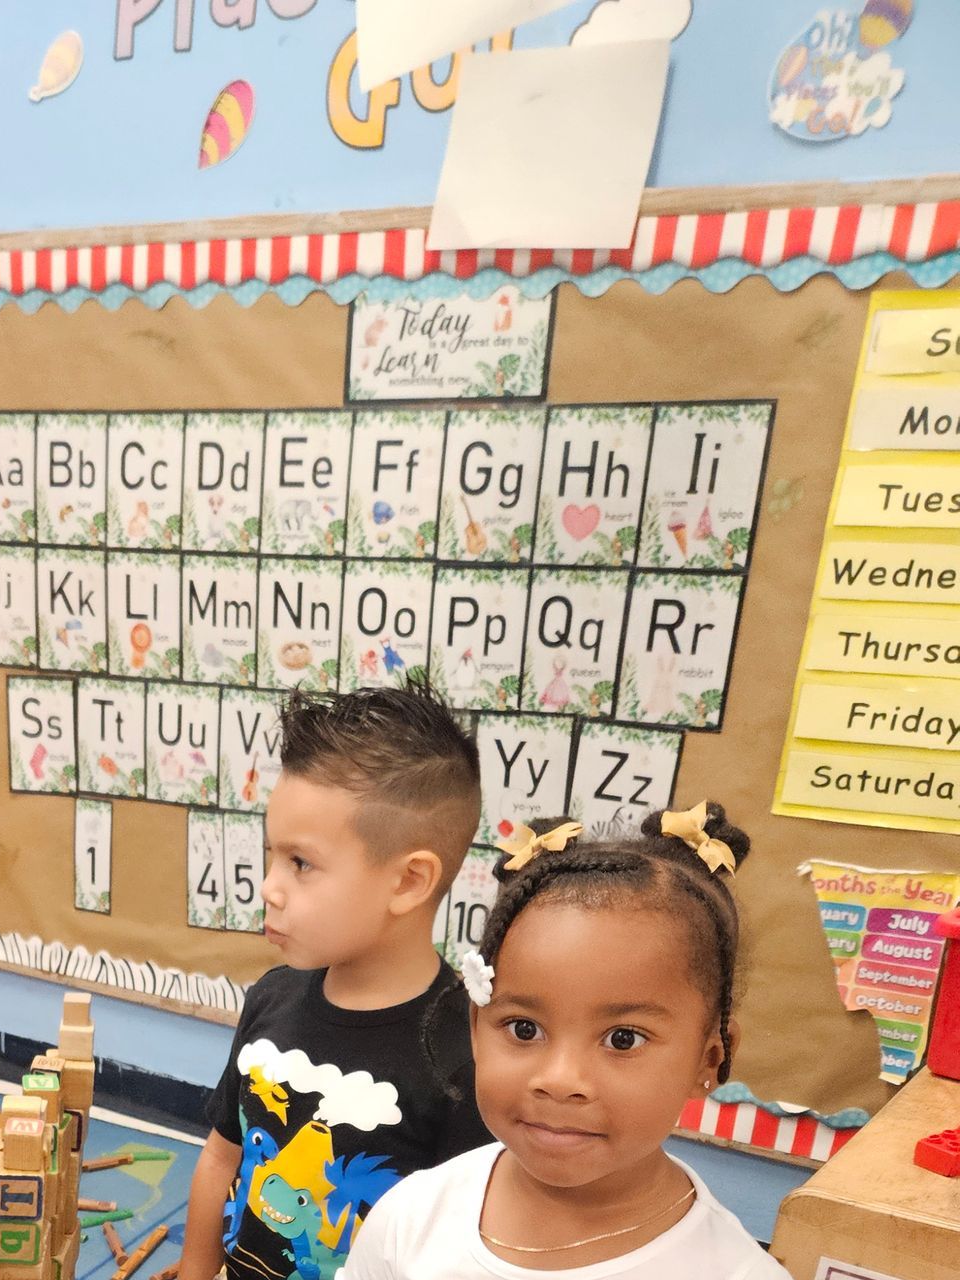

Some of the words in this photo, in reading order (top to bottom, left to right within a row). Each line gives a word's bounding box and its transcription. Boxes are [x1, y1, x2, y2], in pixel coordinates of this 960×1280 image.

[397, 303, 472, 353] Today
[493, 335, 514, 350] day
[373, 346, 440, 377] Learn
[48, 440, 96, 489] Bb
[119, 441, 169, 491] Cc
[197, 441, 250, 492] Dd
[278, 436, 333, 489] Ee
[372, 439, 420, 493] Ff
[458, 440, 524, 510] Gg
[557, 440, 631, 498] Hh
[685, 432, 722, 495] Ii
[604, 510, 633, 522] heart
[49, 569, 96, 617] Kk
[125, 573, 158, 621] Ll
[189, 579, 253, 630] Mm
[272, 580, 331, 631] Nn
[357, 587, 416, 639] Oo
[446, 596, 507, 657] Pp
[538, 595, 604, 663] Qq
[645, 598, 716, 656] Rr
[21, 697, 63, 740] Ss
[92, 698, 125, 744] Tt
[158, 702, 207, 749] Uu
[236, 710, 280, 758] Vv
[495, 738, 550, 798] Yy
[593, 749, 654, 806] Zz
[86, 846, 96, 885] 1
[196, 863, 219, 902] 4
[234, 864, 255, 905] 5
[453, 900, 490, 946] 10
[887, 913, 930, 936] July
[871, 938, 933, 961] August
[858, 966, 933, 990] September
[855, 994, 922, 1015] October
